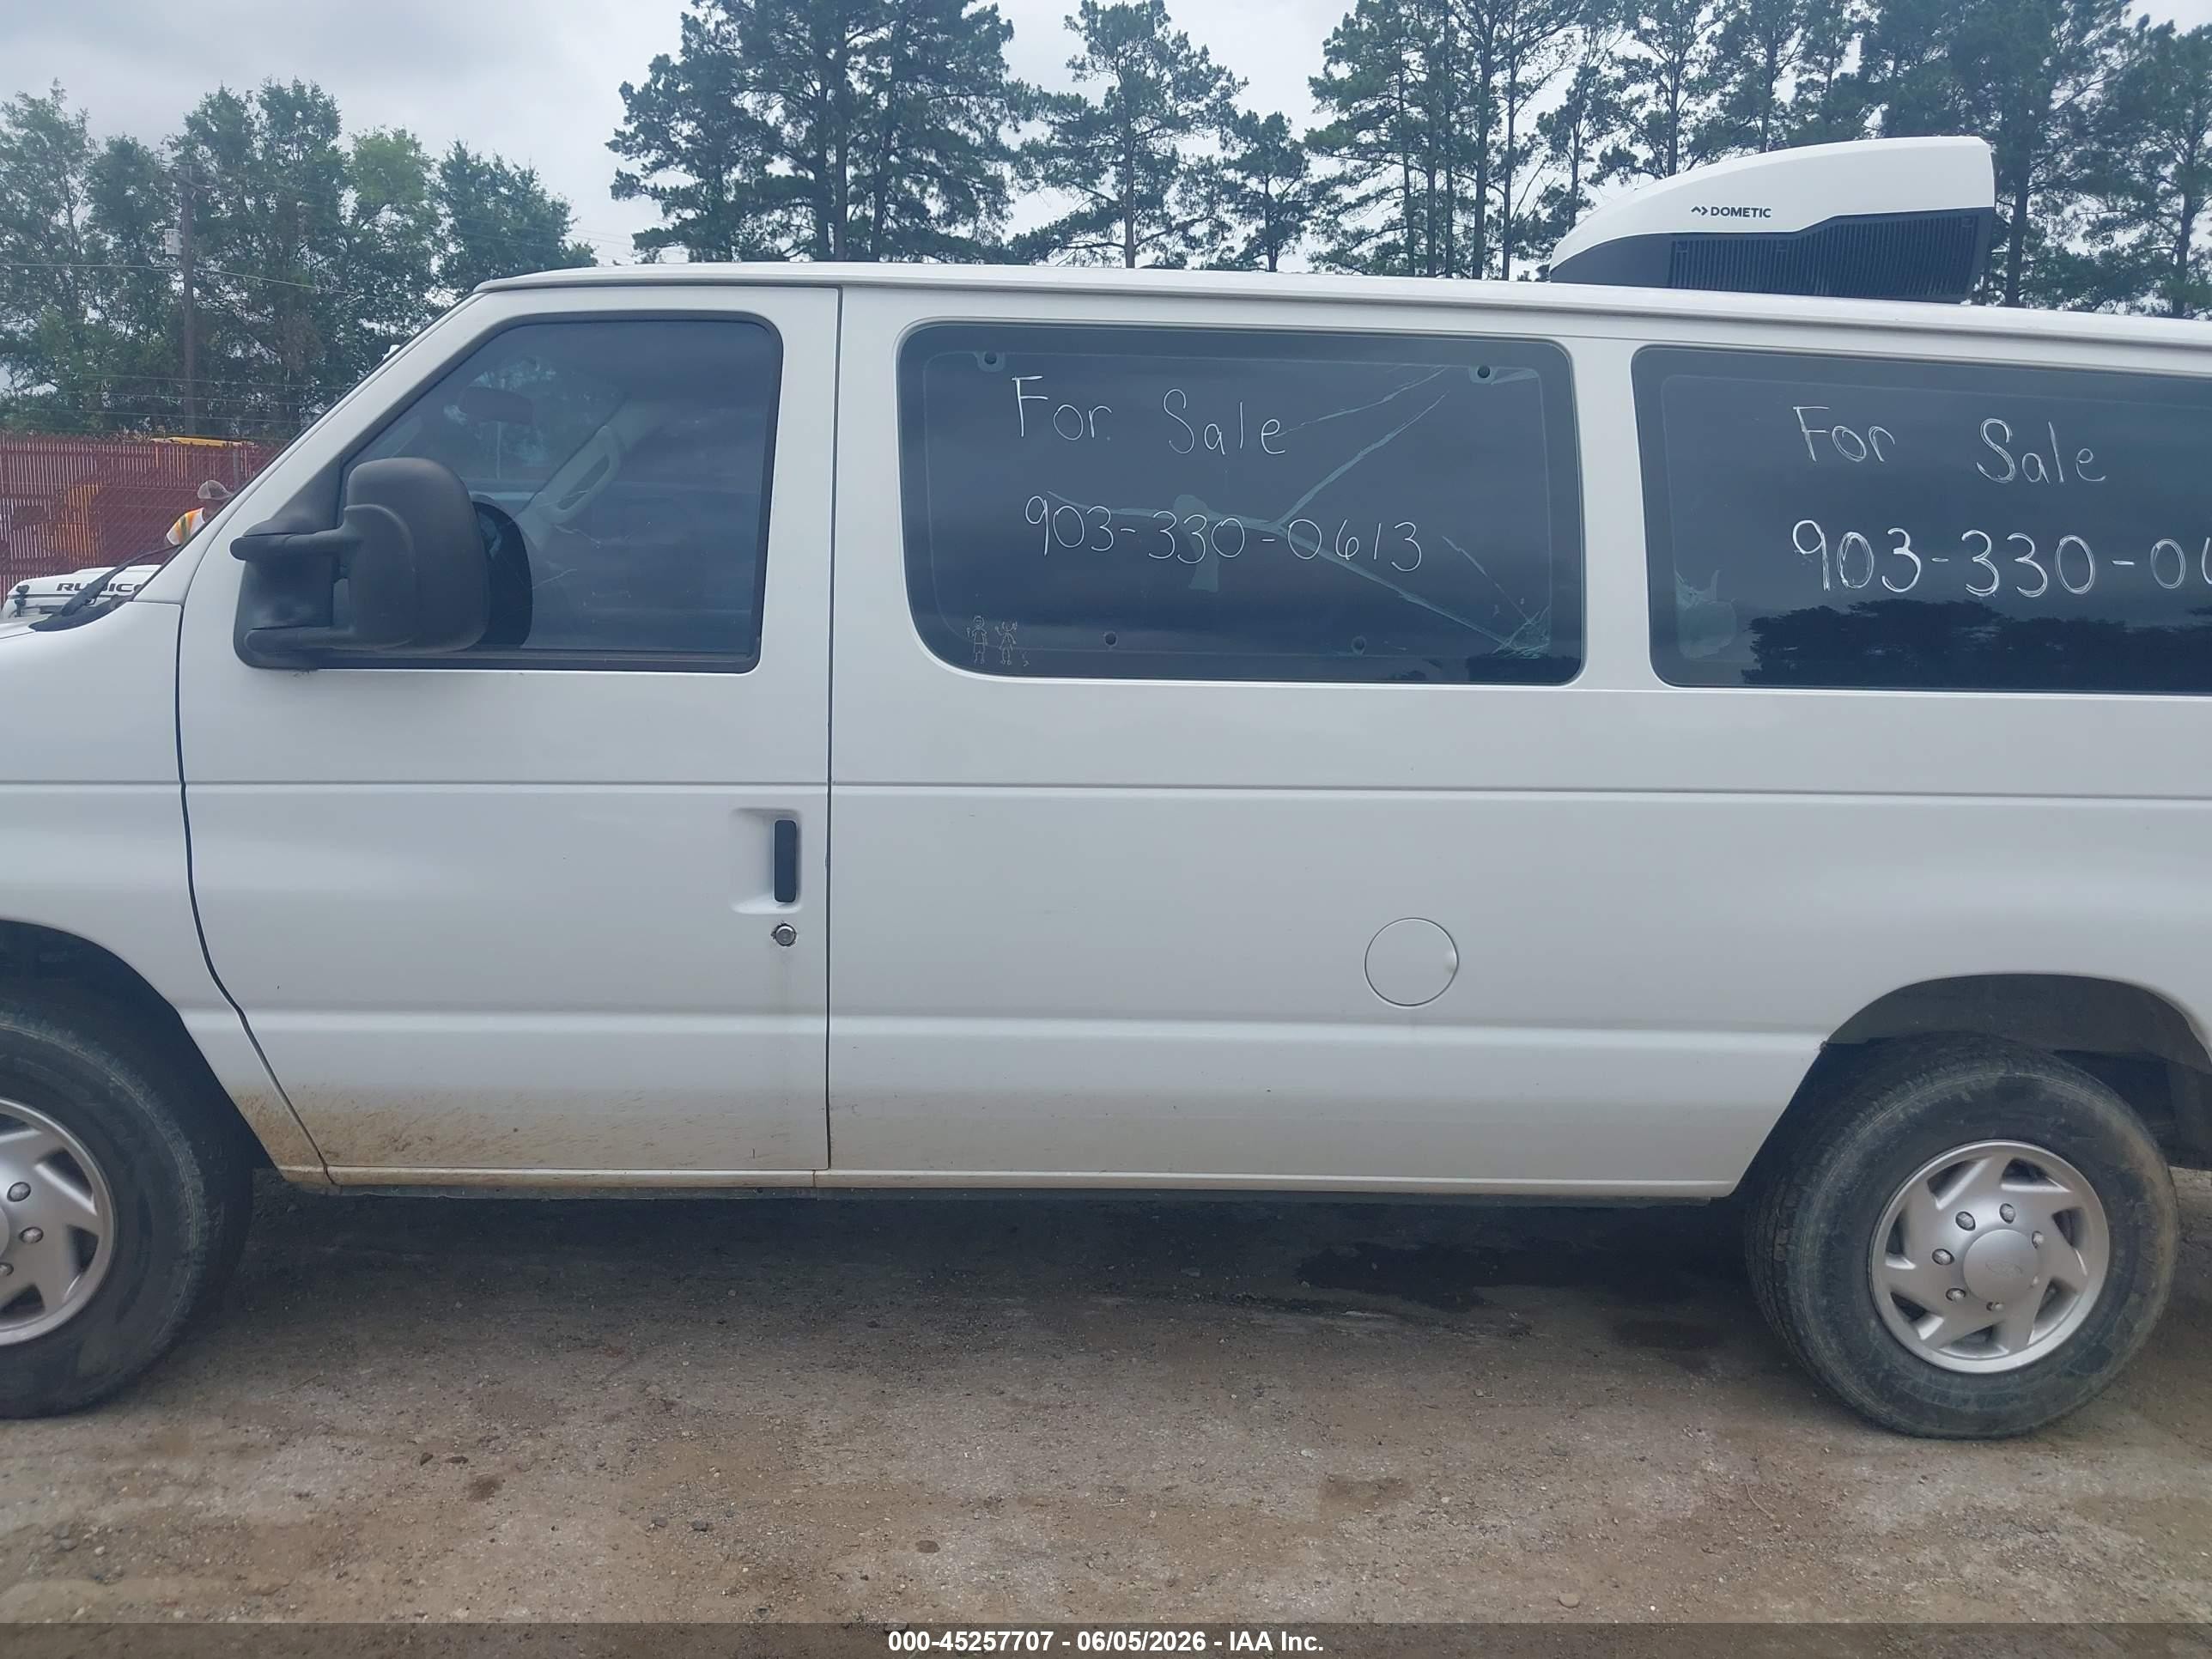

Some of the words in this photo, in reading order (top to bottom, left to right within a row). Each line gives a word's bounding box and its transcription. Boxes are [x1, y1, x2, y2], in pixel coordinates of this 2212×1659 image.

[1710, 206, 1771, 218] DOMETIC
[1163, 388, 1286, 456] Sale
[1793, 405, 1895, 462] For
[1976, 417, 2106, 483] Sale
[1024, 495, 1422, 572] 903-330-0613
